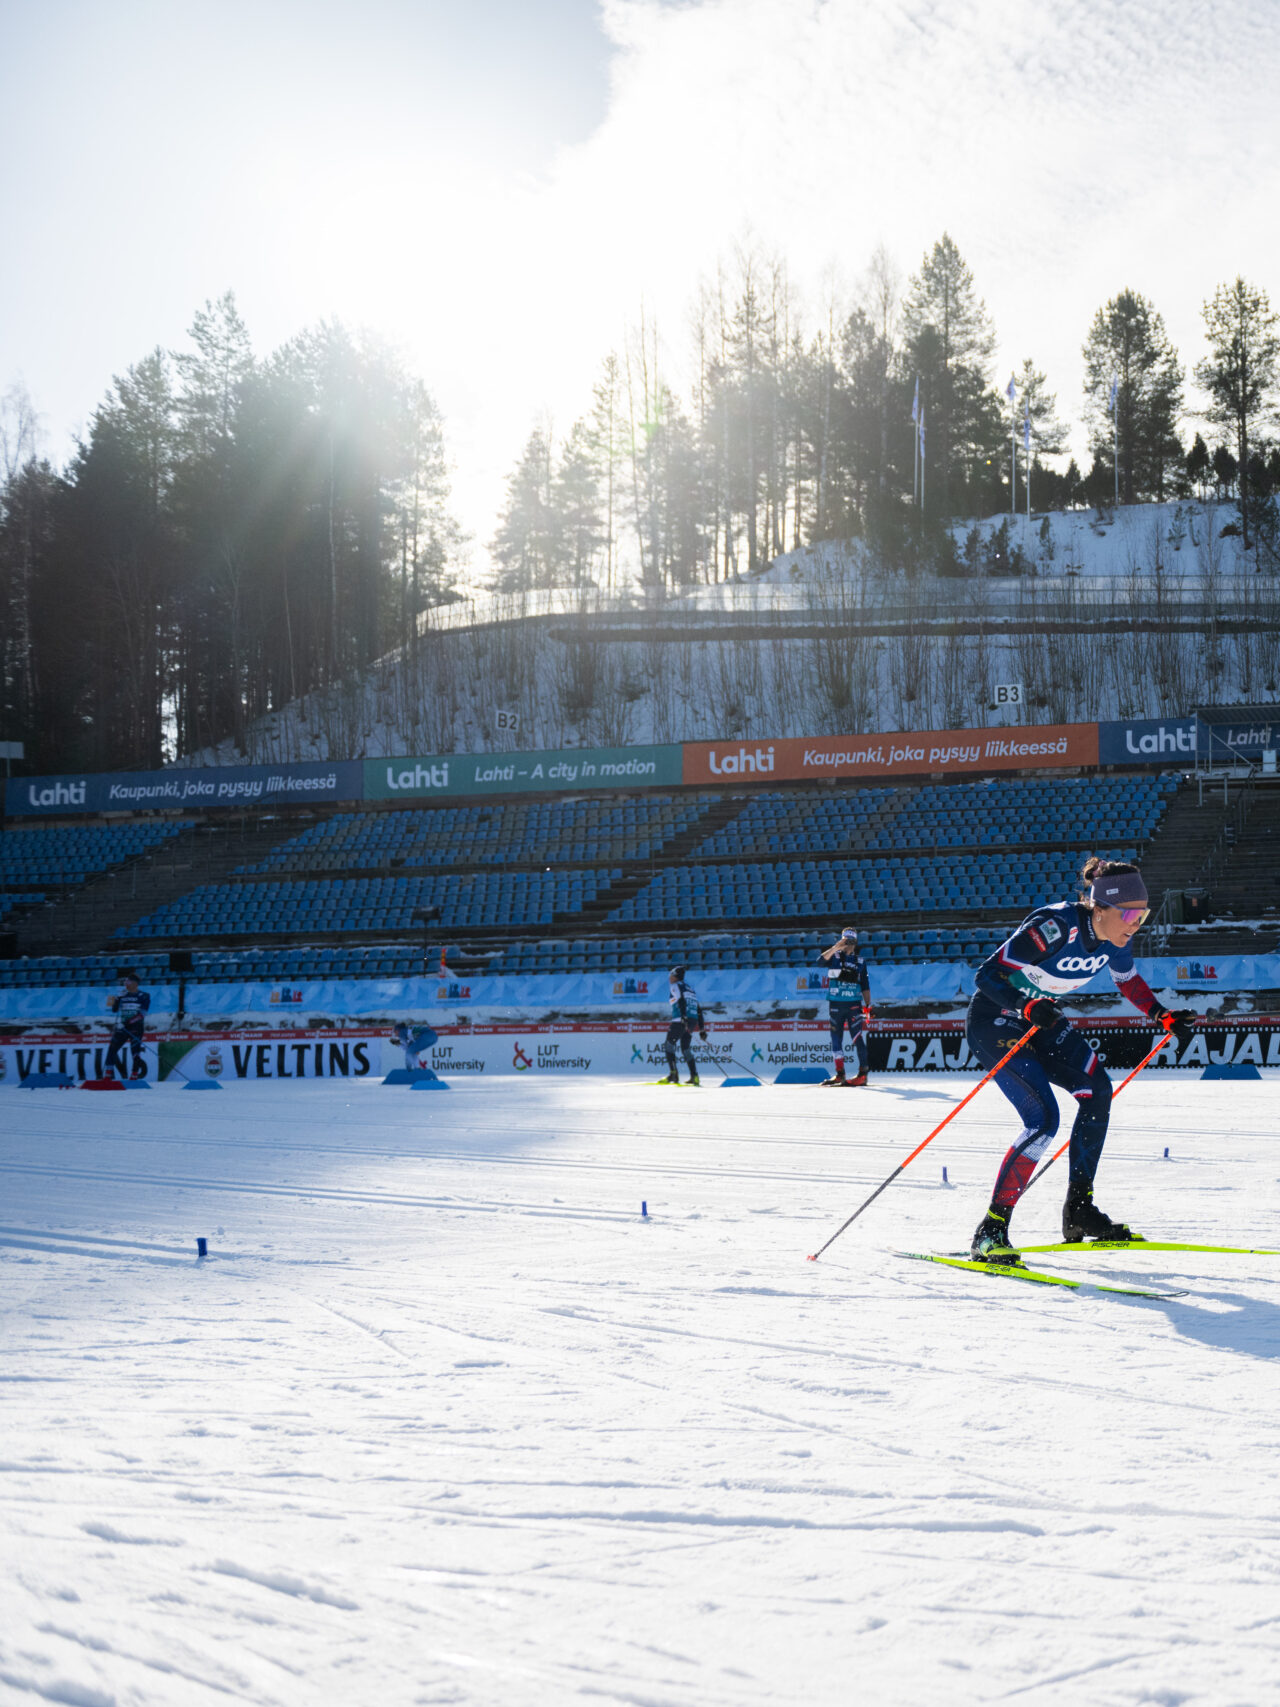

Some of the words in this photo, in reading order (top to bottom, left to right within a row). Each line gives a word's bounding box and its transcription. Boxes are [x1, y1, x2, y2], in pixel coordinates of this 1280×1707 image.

[997, 686, 1019, 702] B3
[498, 713, 518, 729] B2
[1126, 725, 1197, 753] Lahti
[1227, 725, 1271, 746] Lahti
[709, 747, 775, 774] Lahti
[803, 748, 885, 768] Kaupunki,
[886, 746, 924, 765] joka
[929, 742, 980, 764] pysyy
[985, 738, 1068, 758] liikkeessä
[387, 763, 449, 789] Lahti
[474, 764, 515, 782] Lahti
[531, 764, 544, 779] A
[548, 761, 577, 781] city
[581, 761, 596, 777] in
[600, 759, 656, 776] motion
[29, 781, 86, 807] Lahti
[109, 781, 181, 801] Kaupunki,
[181, 780, 215, 799] joka
[218, 778, 263, 798] pysyy
[266, 773, 337, 792] liikkeessä
[1057, 954, 1109, 974] coop
[432, 1047, 454, 1058] LUT
[538, 1045, 560, 1056] LUT
[722, 1043, 733, 1052] of
[768, 1043, 788, 1053] LAB
[232, 1042, 370, 1078] VELTINS
[432, 1058, 485, 1072] University
[538, 1056, 591, 1071] University
[768, 1053, 808, 1065] Applied
[810, 1052, 854, 1064] Scienes
[1091, 1241, 1130, 1249] FISCHER
[985, 1264, 1011, 1272] FISCHER
